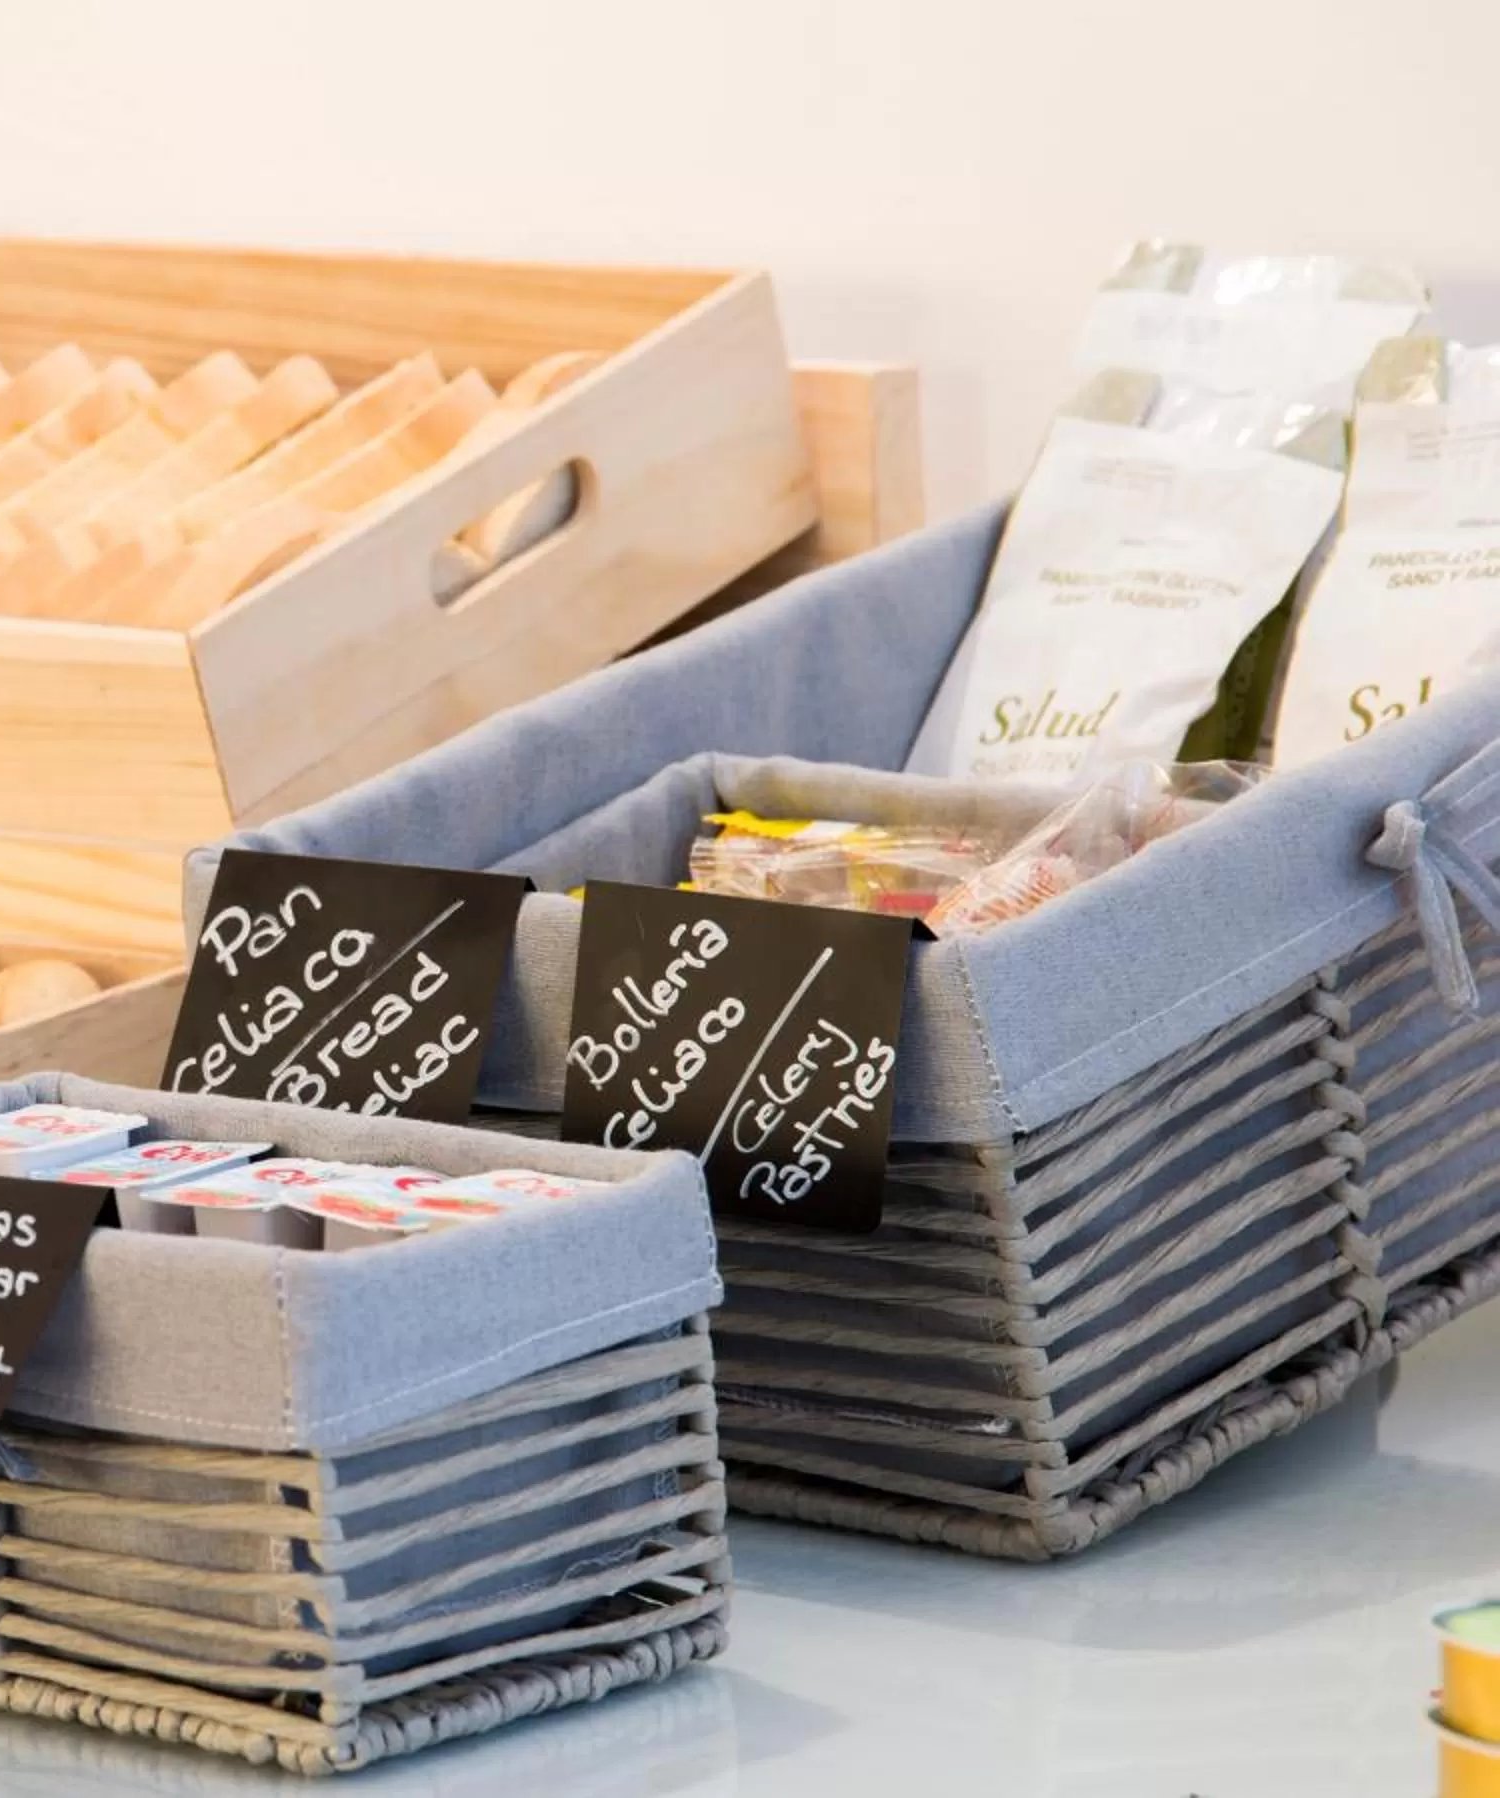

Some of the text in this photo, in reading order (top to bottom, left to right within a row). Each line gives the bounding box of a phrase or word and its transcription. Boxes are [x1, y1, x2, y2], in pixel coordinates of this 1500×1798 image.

[978, 687, 1121, 746] Salud
[200, 885, 323, 977] Pan
[265, 951, 450, 1109] Bread
[337, 1013, 480, 1117] eliac
[732, 1018, 859, 1154] Celery
[739, 1036, 897, 1206] Pastries
